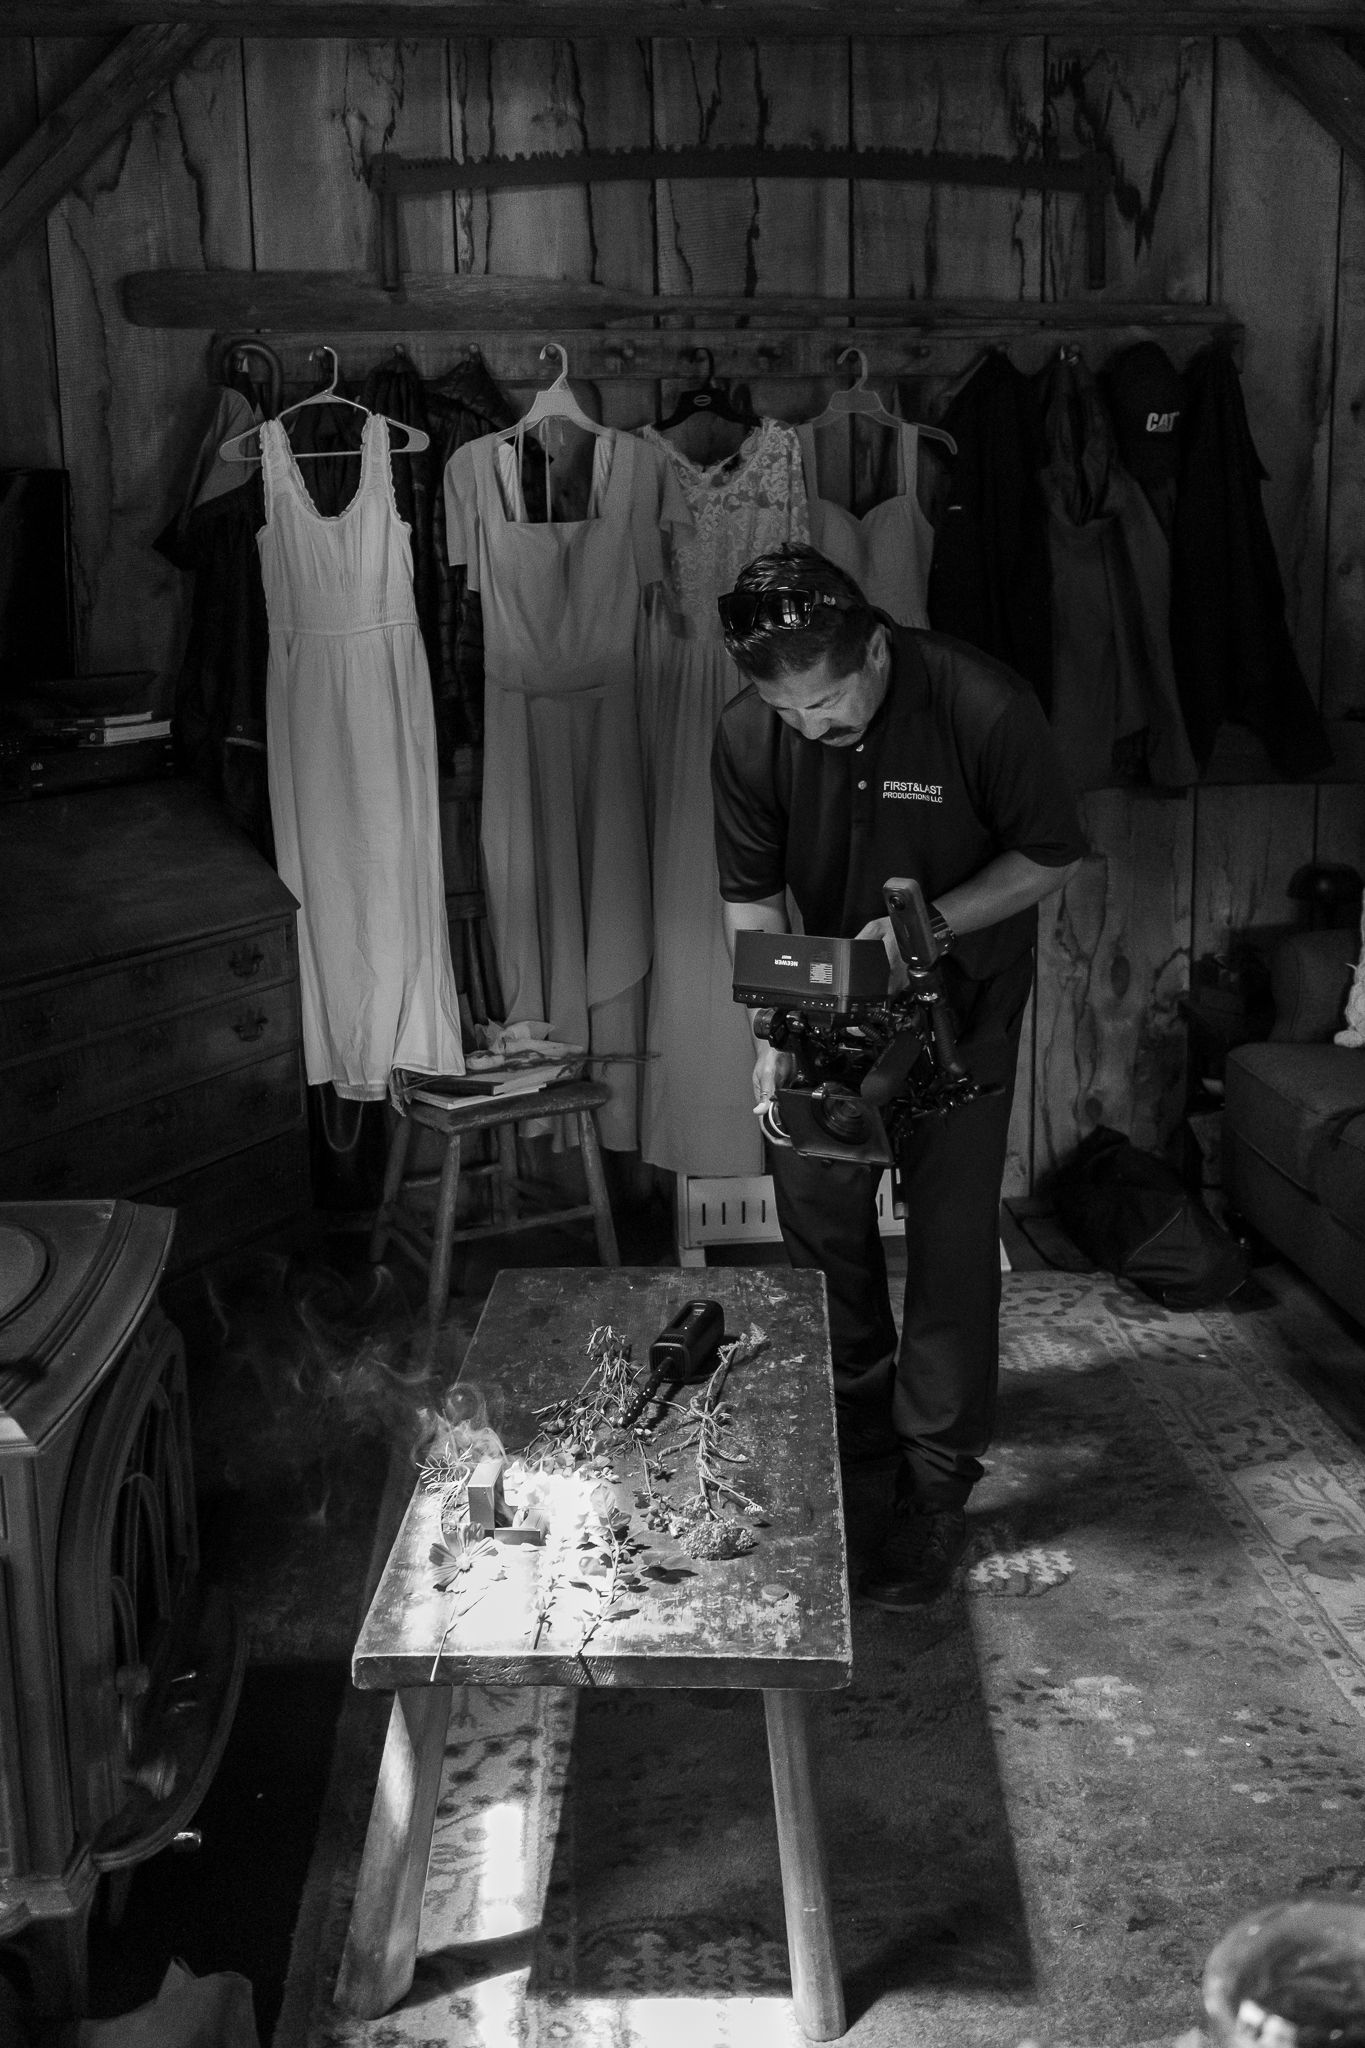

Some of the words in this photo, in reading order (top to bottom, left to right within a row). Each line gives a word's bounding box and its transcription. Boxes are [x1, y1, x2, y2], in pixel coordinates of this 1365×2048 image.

[1146, 411, 1180, 432] CAT
[883, 781, 943, 795] FIRST&LAST
[882, 791, 930, 801] PRODUCTIONS
[774, 959, 799, 967] NEEWER
